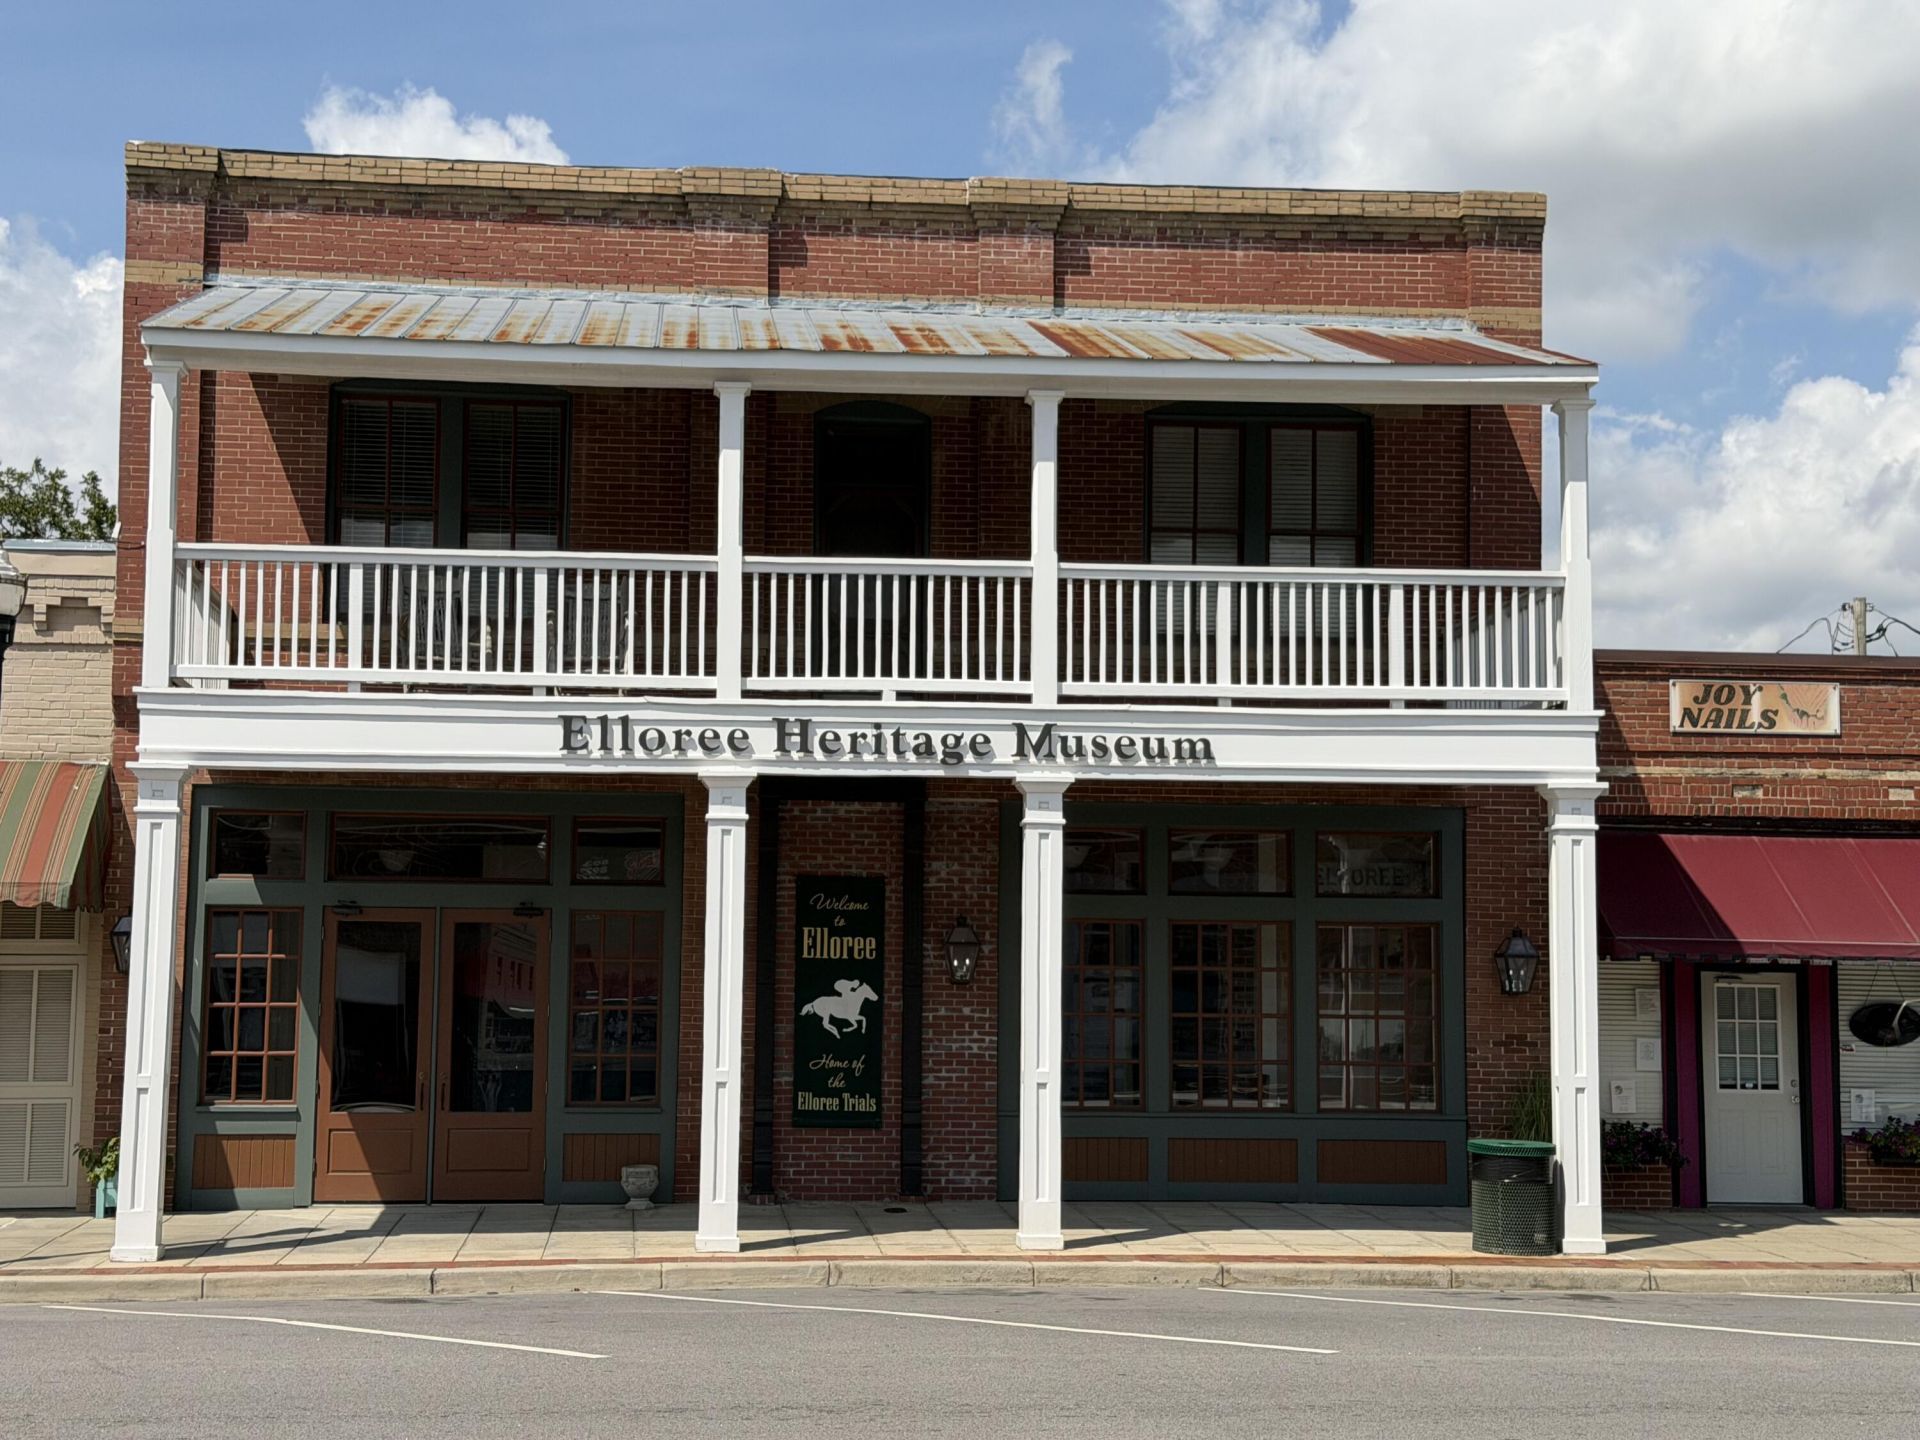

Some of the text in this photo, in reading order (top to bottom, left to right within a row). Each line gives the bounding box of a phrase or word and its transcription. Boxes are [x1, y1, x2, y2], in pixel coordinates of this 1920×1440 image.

[1692, 683, 1764, 706] JOY
[1678, 707, 1780, 730] NAILS
[558, 714, 1215, 767] Elloree Heritage Museum
[809, 893, 869, 911] Welcome
[834, 915, 846, 927] to
[802, 927, 877, 960] Elloree
[809, 1053, 865, 1076] Home of
[827, 1072, 846, 1088] the
[797, 1091, 877, 1112] Elloree Trials
